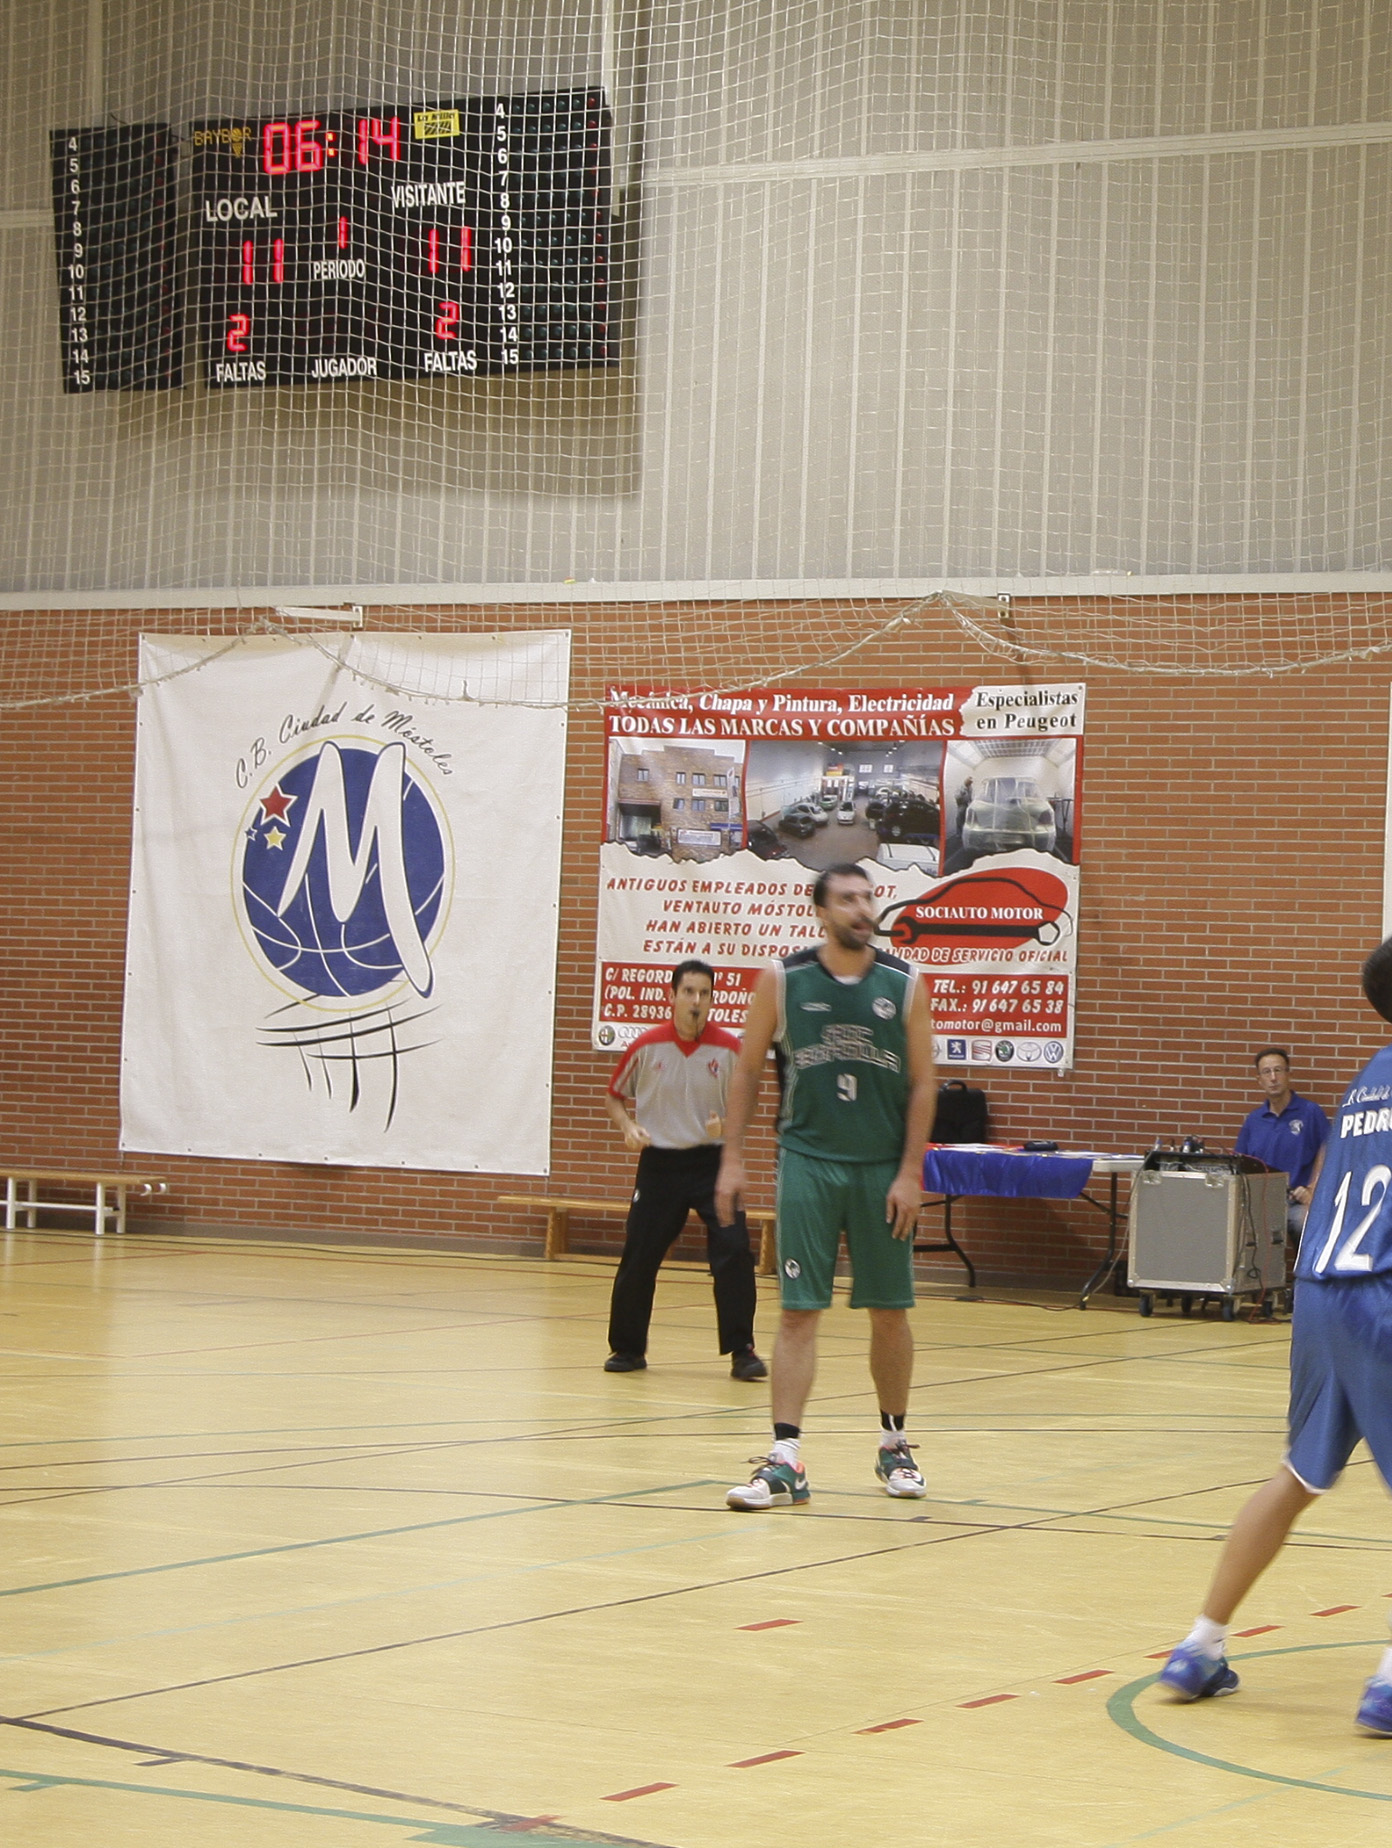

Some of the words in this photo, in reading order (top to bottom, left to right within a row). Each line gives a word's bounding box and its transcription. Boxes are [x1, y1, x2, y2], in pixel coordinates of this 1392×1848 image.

[495, 103, 505, 119] 4
[497, 126, 507, 142] 5
[68, 137, 78, 151] 4
[497, 148, 508, 164] 6
[70, 159, 79, 172] 5
[71, 180, 80, 193] 6
[499, 171, 509, 186] 7
[391, 181, 466, 208] VISITANTE
[500, 192, 510, 208] 8
[71, 201, 81, 215] 7
[205, 196, 278, 222] LOCAL
[73, 222, 82, 236] 8
[501, 215, 511, 231] 9
[74, 243, 83, 257] 9
[429, 225, 472, 273] 11
[495, 237, 512, 253] 10
[243, 238, 284, 285] 11
[313, 258, 366, 280] PERIODO
[496, 260, 512, 275] 11
[68, 264, 84, 279] 10
[69, 286, 84, 300] 11
[497, 282, 515, 298] 12
[71, 307, 87, 321] 12
[499, 304, 517, 320] 13
[436, 301, 460, 340] 2
[71, 328, 88, 342] 13
[227, 313, 250, 352] 2
[500, 326, 518, 342] 14
[73, 349, 89, 363] 14
[424, 350, 478, 372] FALTAS
[501, 349, 519, 365] 15
[216, 361, 267, 382] FALTAS
[311, 357, 377, 378] JUGADOR
[74, 370, 90, 384] 15
[699, 692, 752, 714] Chapa
[756, 698, 767, 714] y
[771, 694, 843, 715] Pintura,
[848, 693, 954, 712] Electricidad
[976, 690, 1078, 711] Especialistas
[609, 715, 675, 734] TODAS
[679, 717, 716, 735] LAS
[721, 718, 803, 736] MARCAS
[810, 719, 822, 736] Y
[827, 714, 954, 737] COMPAÑÍAS
[977, 716, 997, 730] en
[1004, 713, 1077, 733] Peugeot
[279, 701, 347, 744] Ciudad
[352, 704, 375, 724] de
[381, 710, 453, 776] Móstoles
[606, 877, 688, 893] ANTIGUOS
[692, 880, 788, 897] EMPLEADOS
[793, 883, 814, 898] DE
[663, 900, 742, 915] VENTAUTO
[747, 899, 815, 917] MÓSTOL
[916, 906, 988, 919] SOCIAUTO
[990, 907, 1044, 920] MOTOR
[645, 919, 681, 933] HAN
[686, 920, 752, 936] ABIERTO
[758, 923, 782, 937] UN
[789, 925, 826, 939] TALL
[643, 937, 697, 954] ESTÁN
[701, 942, 711, 955] A
[717, 942, 739, 956] SU
[931, 947, 949, 963] DE
[952, 948, 1013, 963] SERVICIO
[1019, 950, 1068, 963] OFICIAL
[605, 968, 617, 982] C/
[621, 968, 673, 984] REGORD
[726, 972, 741, 987] 51
[604, 986, 635, 1001] (POL.
[640, 988, 666, 1001] IND.
[932, 979, 966, 993] TEL.:
[971, 980, 988, 994] 91
[991, 980, 1018, 994] 647
[1020, 980, 1041, 994] 65
[1045, 981, 1064, 995] 84
[604, 1003, 628, 1018] C.P.
[633, 1005, 672, 1019] 28936
[707, 1008, 749, 1023] TOLES
[930, 997, 967, 1012] FAX.:
[972, 999, 987, 1013] 91
[989, 999, 1017, 1013] 647
[1022, 999, 1041, 1013] 65
[1045, 1000, 1064, 1014] 38
[931, 1018, 1062, 1033] tomotor@gmail.com
[837, 1073, 857, 1101] 9
[1315, 1164, 1392, 1273] 12
